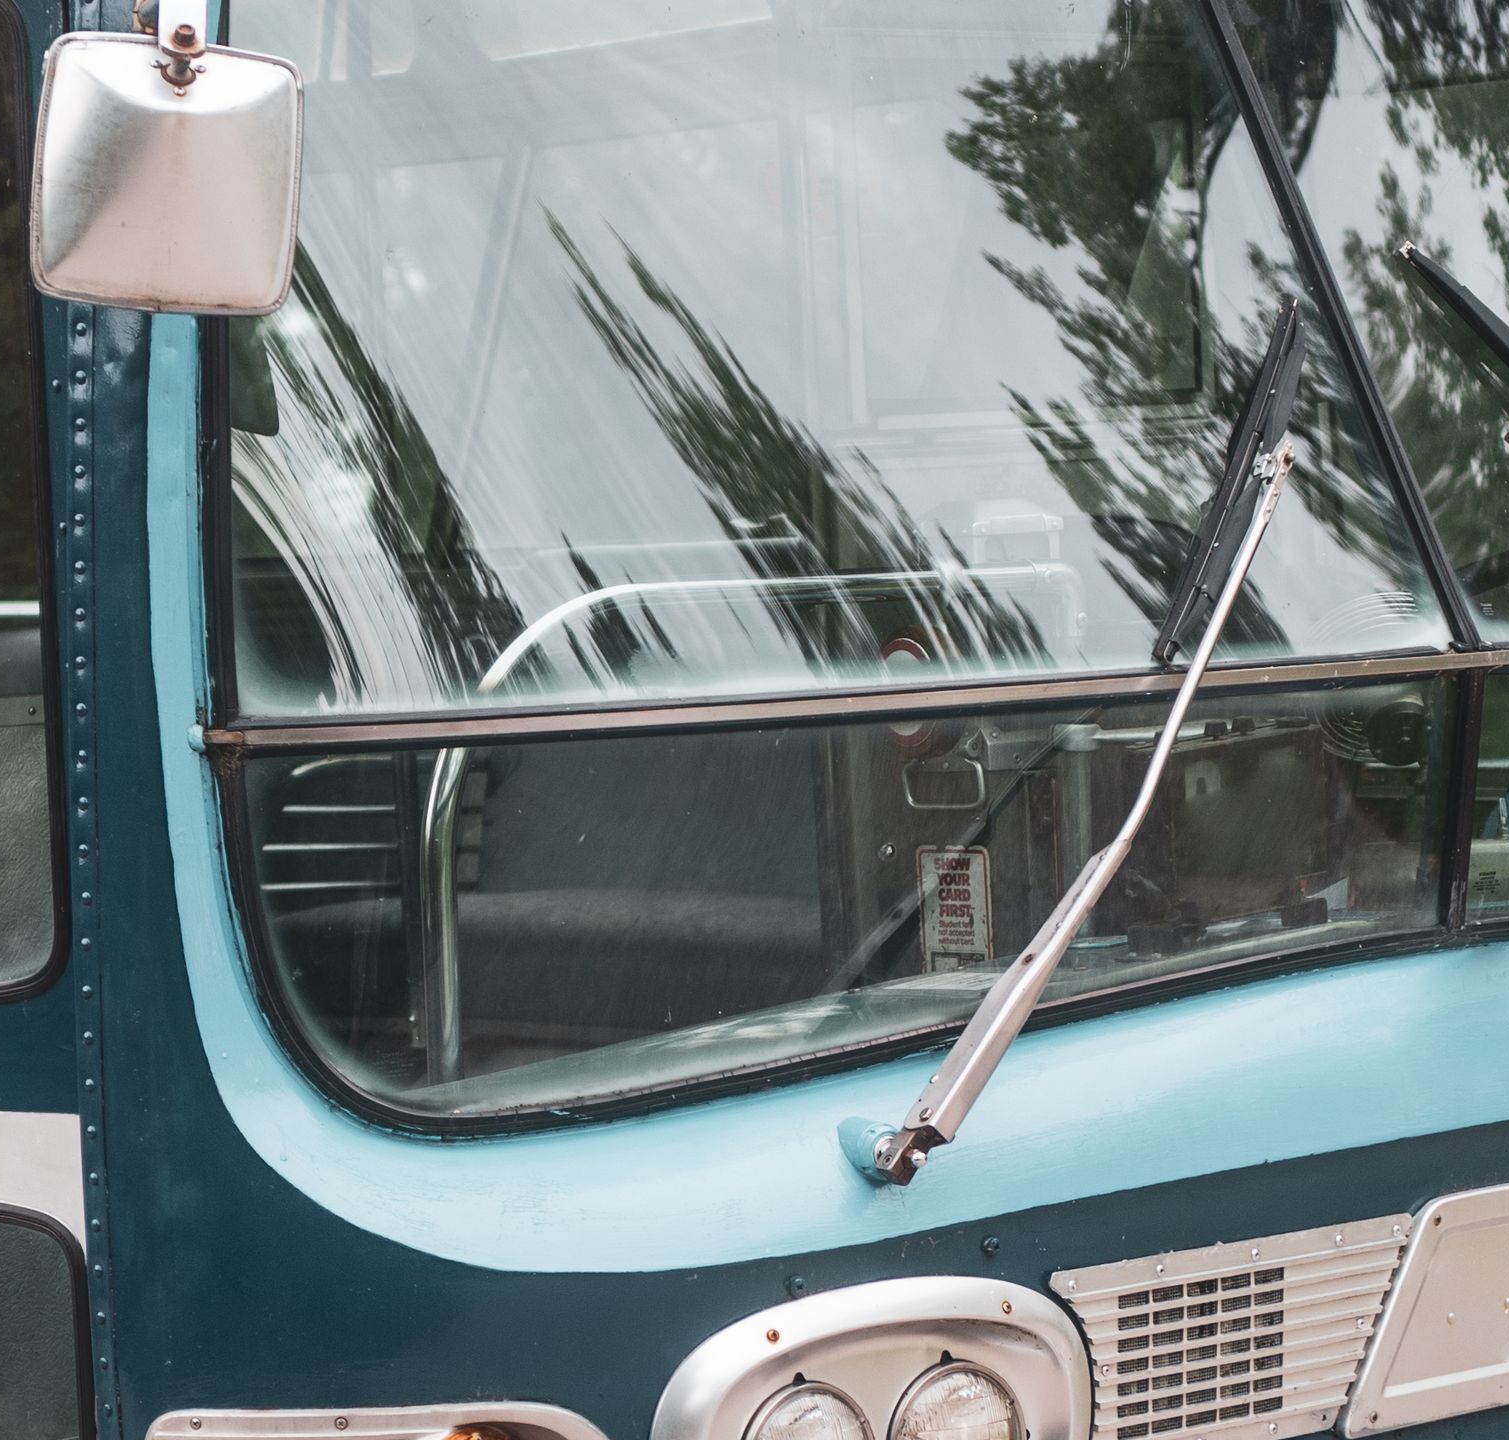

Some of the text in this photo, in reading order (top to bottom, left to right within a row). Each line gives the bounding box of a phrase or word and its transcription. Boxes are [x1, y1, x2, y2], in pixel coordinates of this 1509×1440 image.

[934, 858, 970, 871] SHOW
[937, 873, 970, 886] YOUR
[938, 888, 970, 900] CARD
[939, 904, 972, 917] FIRST
